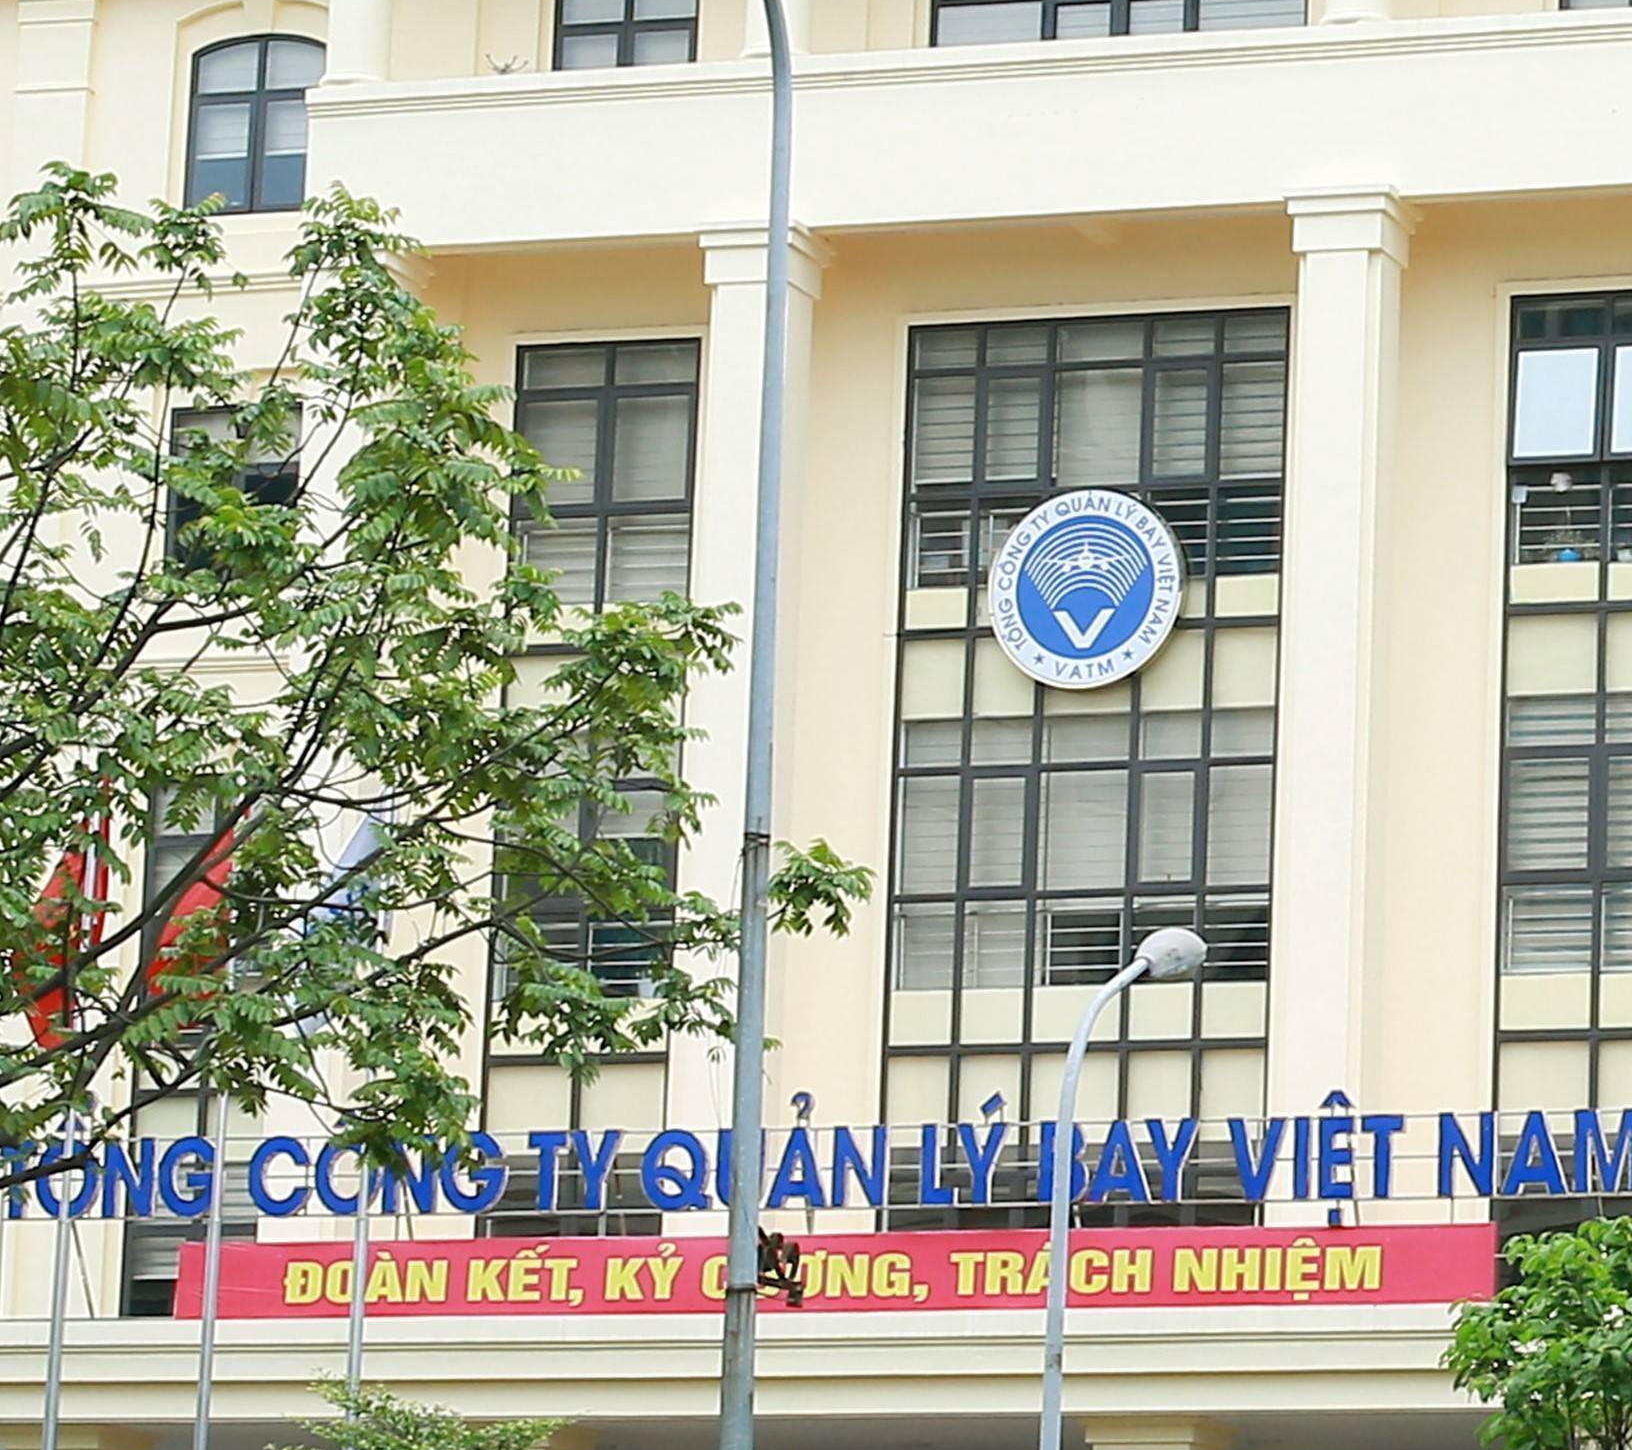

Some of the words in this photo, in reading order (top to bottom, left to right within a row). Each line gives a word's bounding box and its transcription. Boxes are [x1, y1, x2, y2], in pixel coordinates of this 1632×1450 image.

[1031, 510, 1050, 534] TY
[1055, 491, 1110, 516] QUẢN
[1115, 496, 1137, 520] LÝ
[1136, 516, 1166, 549] BAY
[997, 531, 1032, 590] CÔNG
[1156, 552, 1177, 594] VIỆT
[1138, 598, 1170, 645] NAM
[1055, 659, 1115, 679] VATM
[528, 1130, 627, 1211] TY
[921, 1092, 1008, 1205] LÝ
[1038, 1118, 1199, 1202] BAY
[1228, 1090, 1404, 1226] VIỆT
[284, 1251, 446, 1304] ĐOÀN
[466, 1244, 583, 1308] KẾT,
[604, 1242, 684, 1301] KỶ
[1173, 1237, 1383, 1301] NHIỆM
